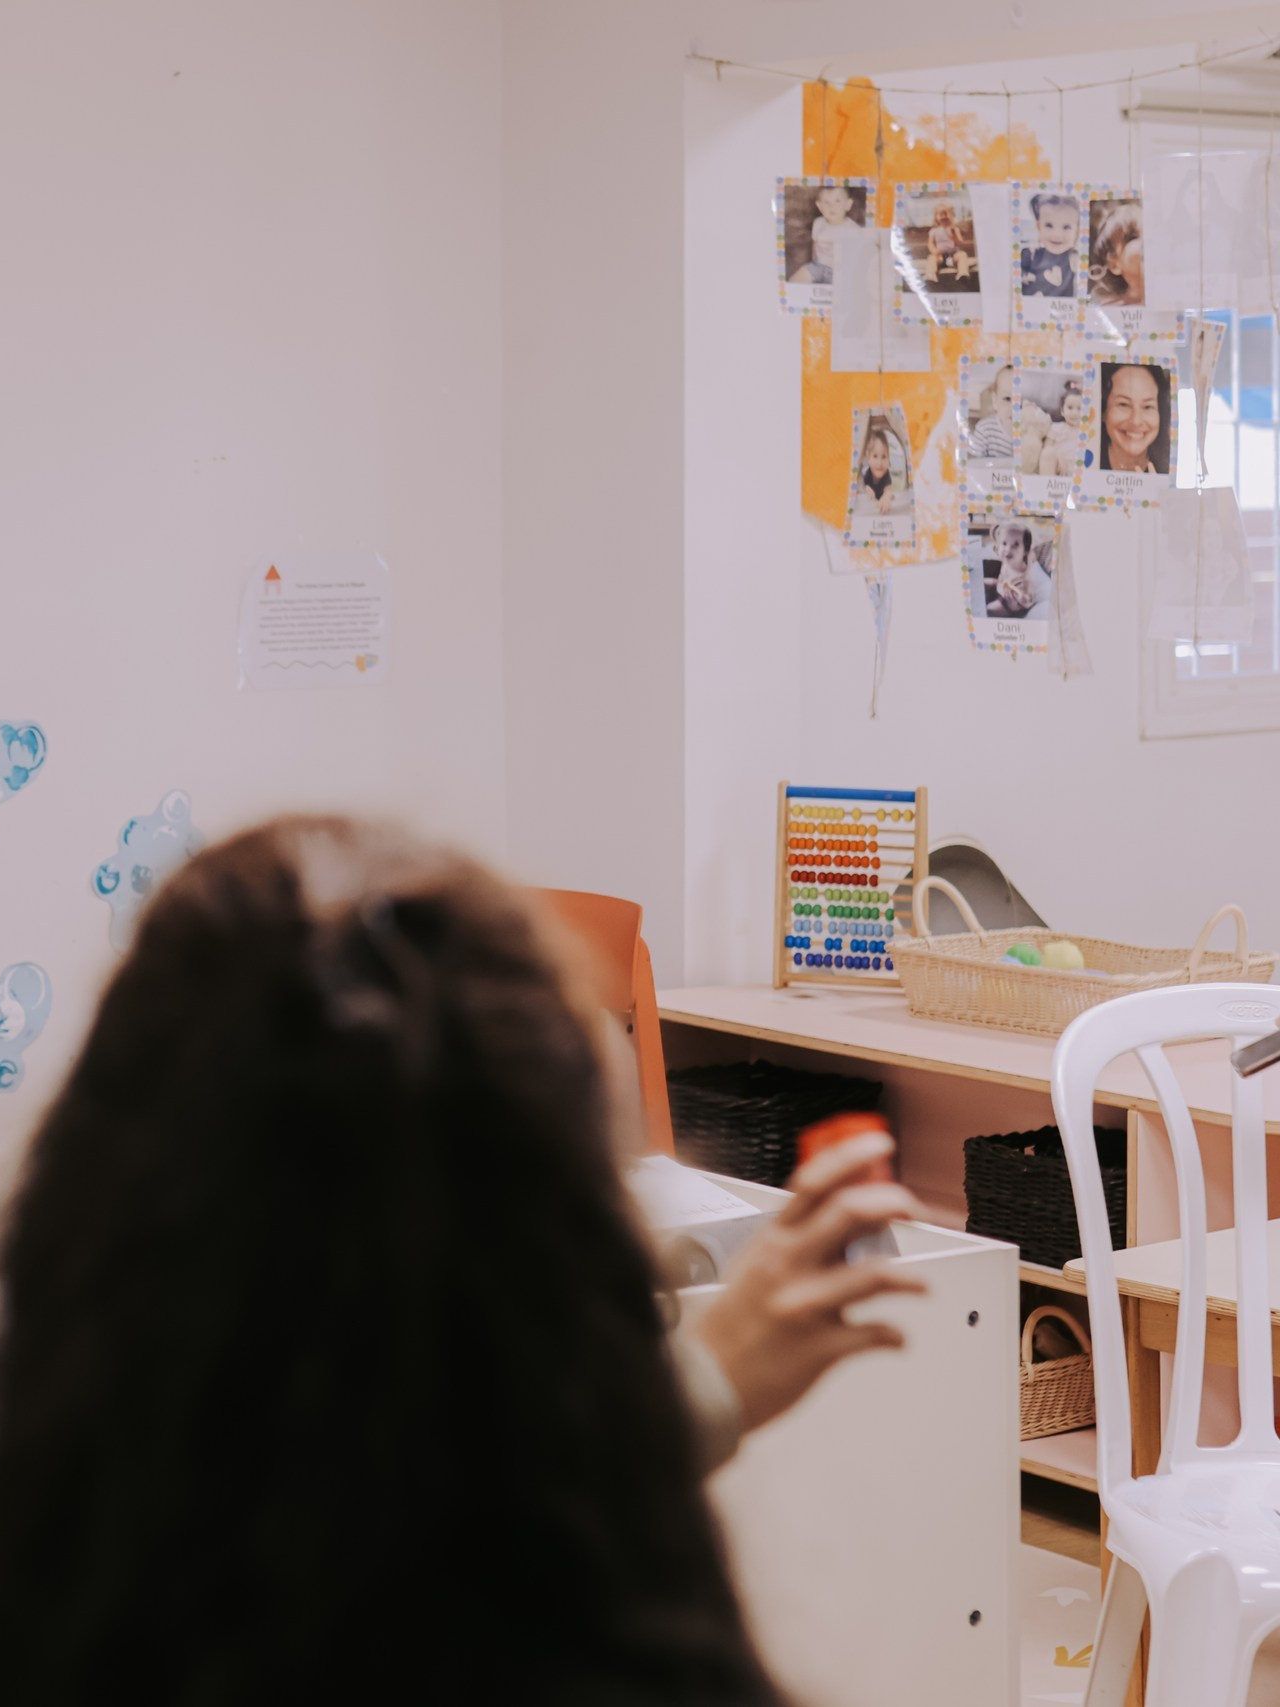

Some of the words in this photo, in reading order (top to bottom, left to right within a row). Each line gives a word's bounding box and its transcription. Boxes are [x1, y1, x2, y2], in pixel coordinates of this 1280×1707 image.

[1050, 300, 1073, 312] Alex
[1120, 310, 1143, 321] Yuli
[1106, 473, 1143, 487] Caitlin
[997, 621, 1021, 633] Dani
